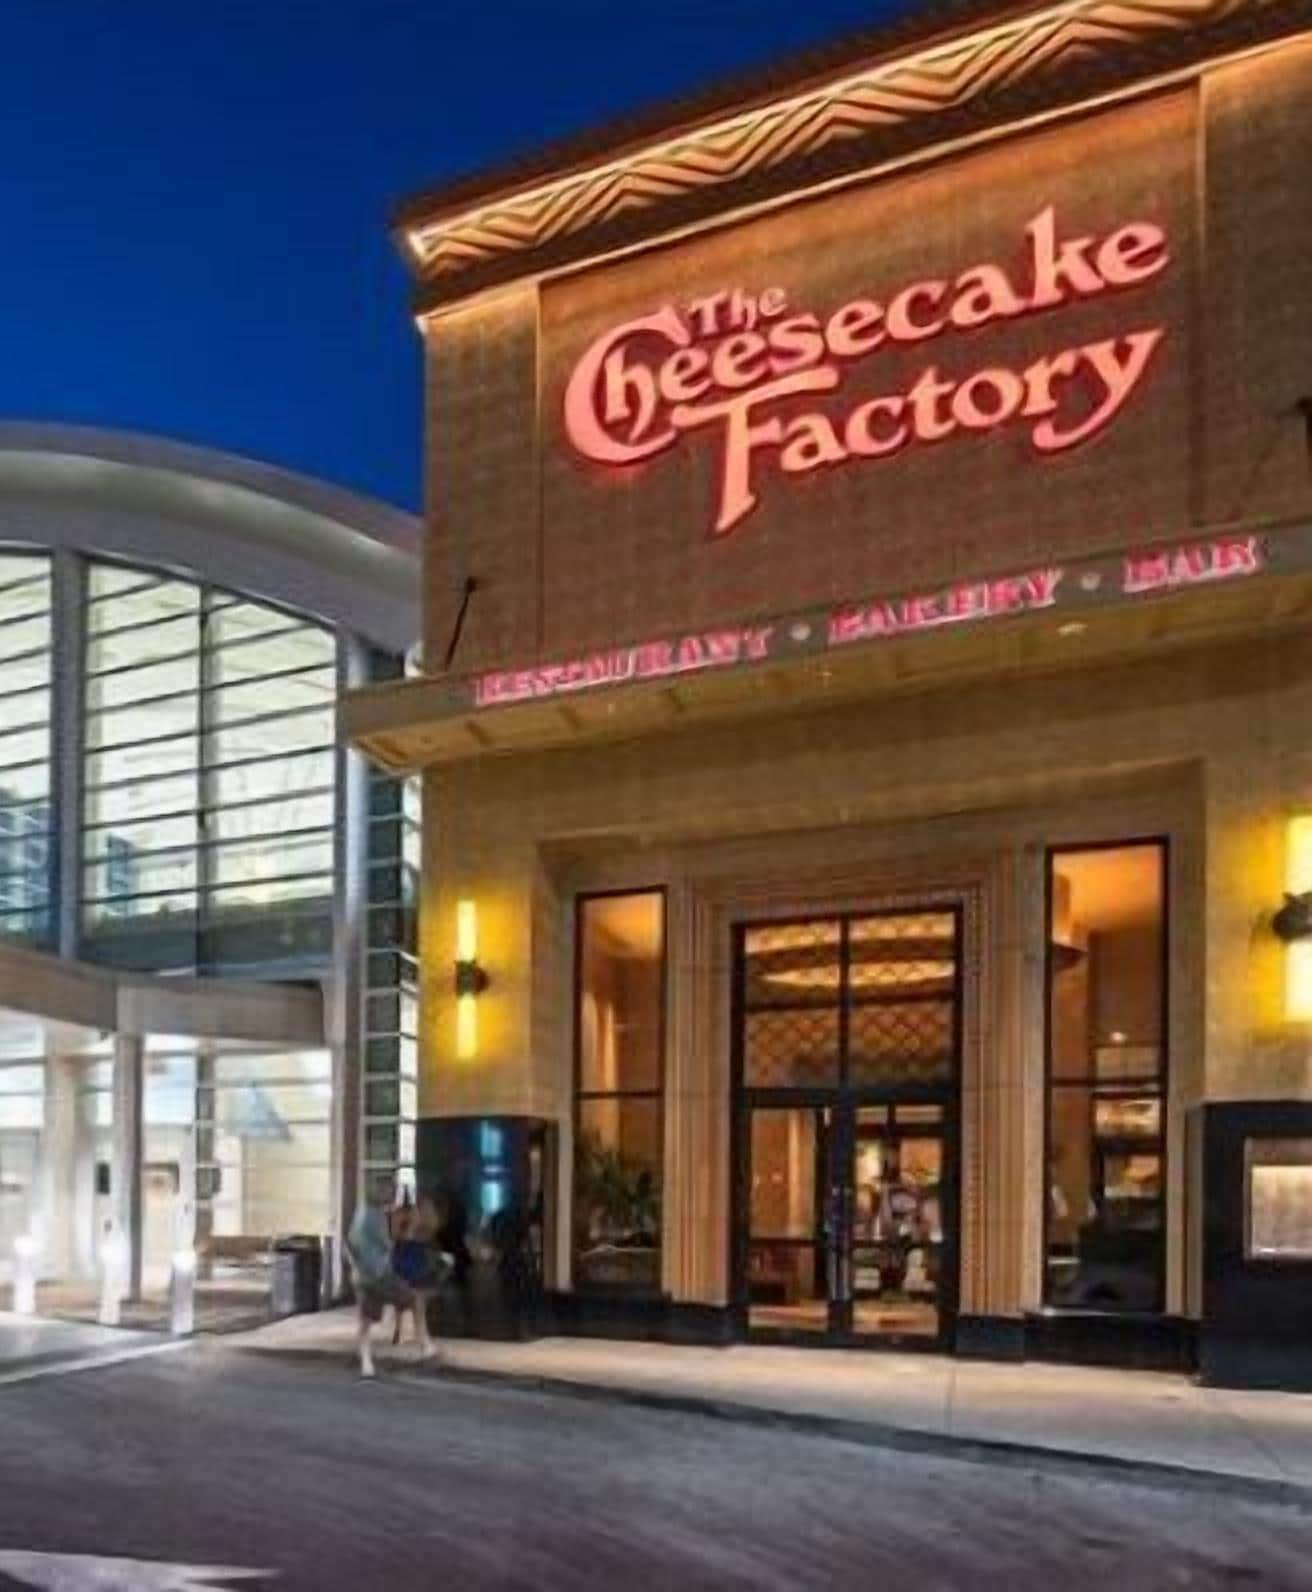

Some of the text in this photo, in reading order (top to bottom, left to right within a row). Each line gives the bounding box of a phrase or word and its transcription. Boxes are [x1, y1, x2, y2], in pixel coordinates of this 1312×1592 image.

[564, 206, 1170, 465] Cheesecake
[688, 287, 787, 335] The
[671, 328, 1165, 533] Factory
